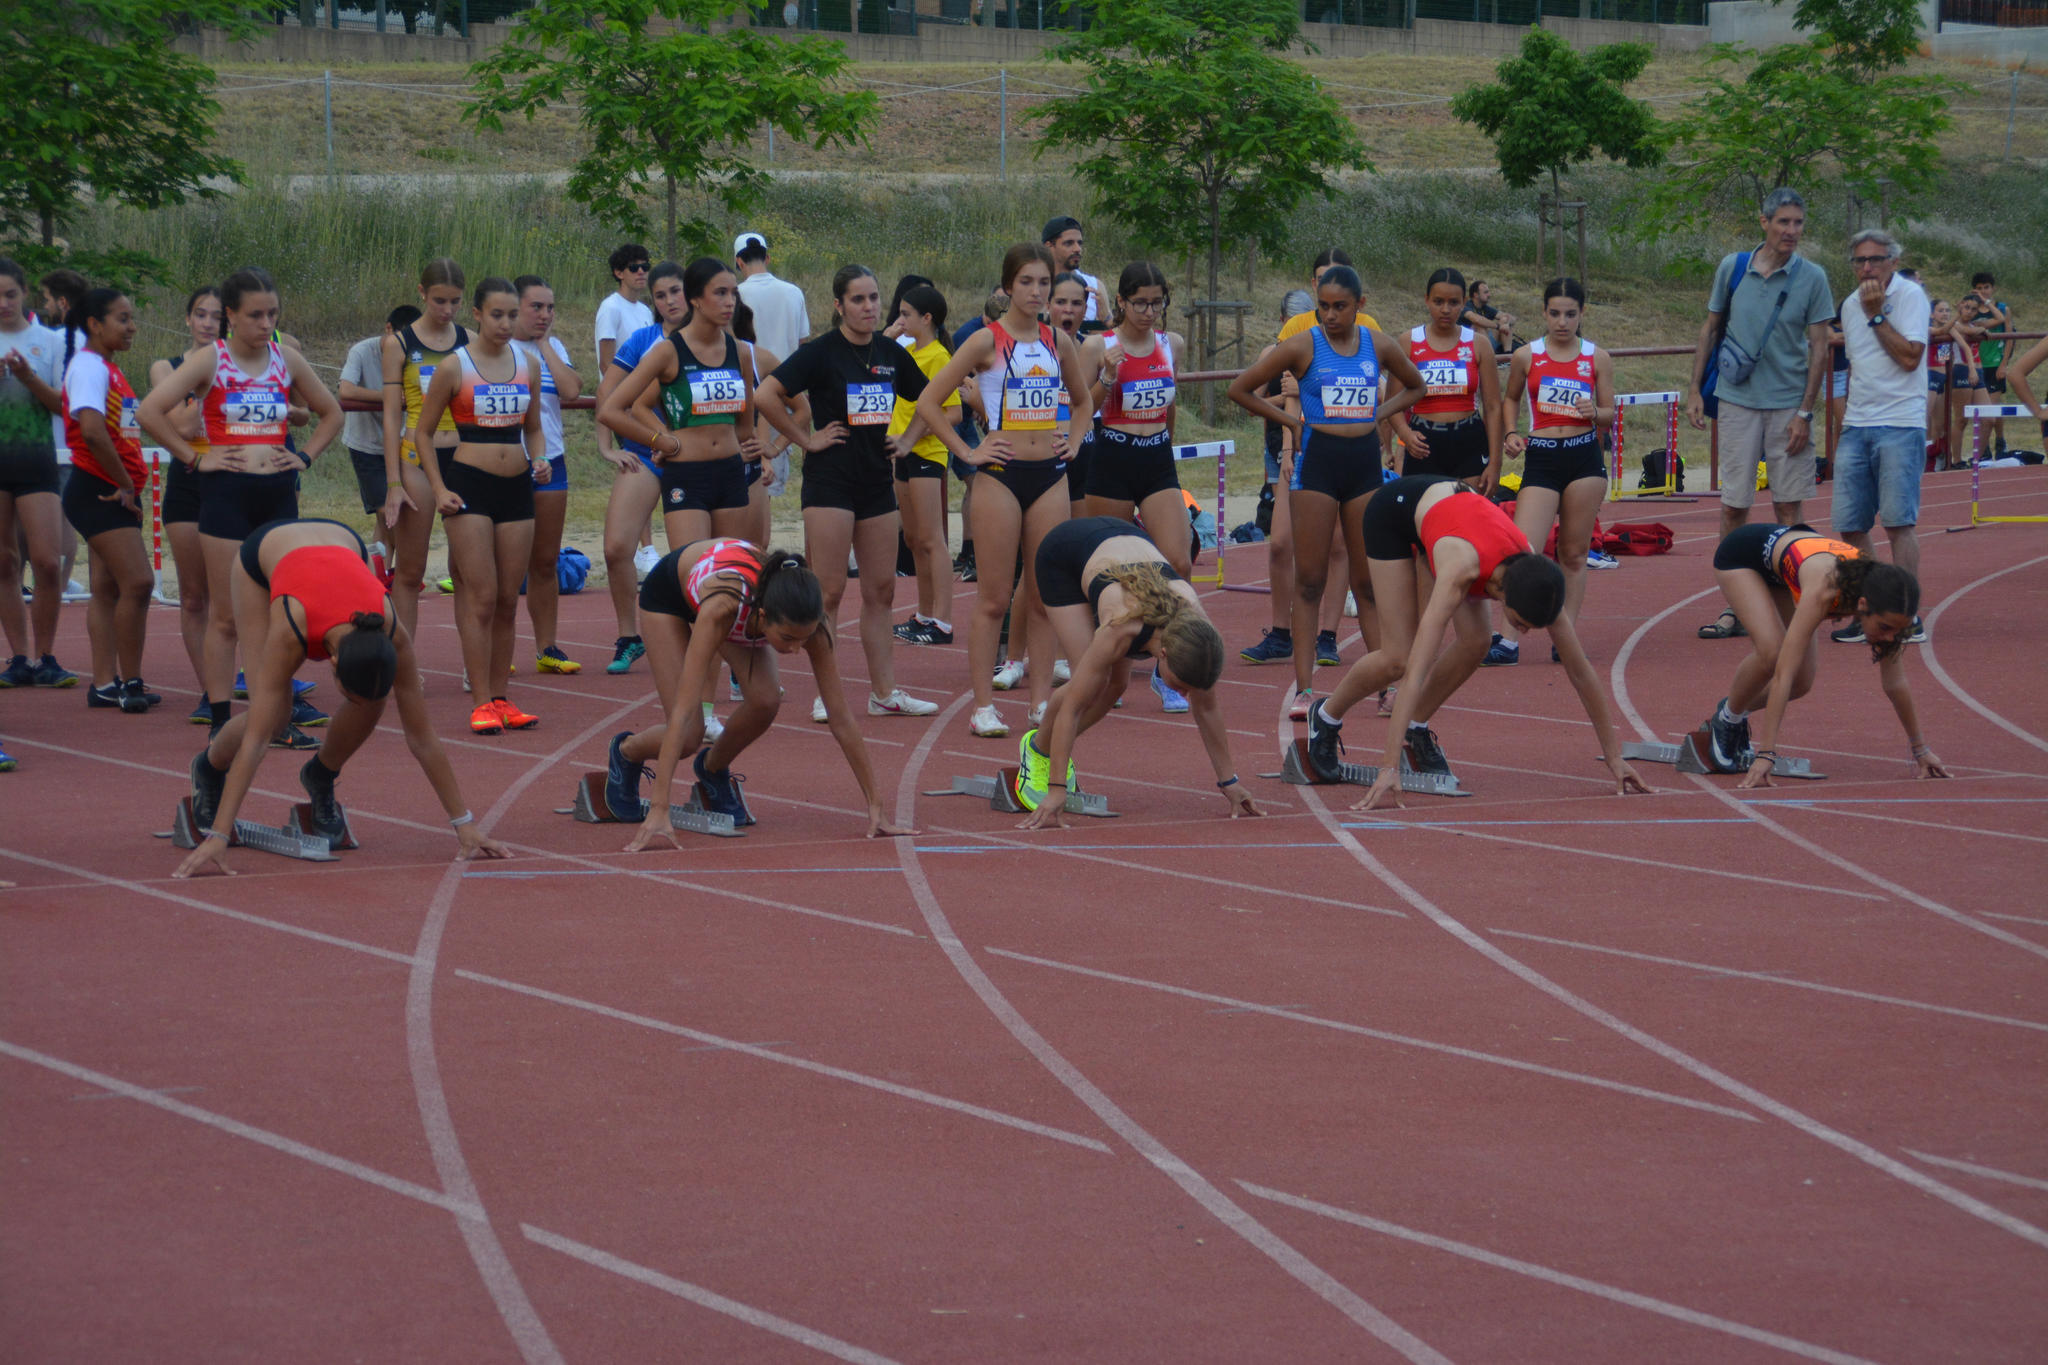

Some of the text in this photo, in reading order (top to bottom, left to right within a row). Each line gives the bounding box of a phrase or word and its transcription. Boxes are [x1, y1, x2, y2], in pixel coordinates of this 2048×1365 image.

[1424, 369, 1458, 385] 241
[702, 382, 737, 401] 185
[1018, 389, 1053, 408] 106
[1132, 390, 1166, 410] 255
[1332, 387, 1368, 406] 276
[1547, 387, 1582, 407] 240
[485, 396, 520, 415] 311
[858, 394, 889, 413] 239
[238, 405, 277, 423] 254
[1131, 434, 1161, 447] NIKE
[1531, 438, 1557, 448] PRO
[1563, 433, 1593, 447] NIKE
